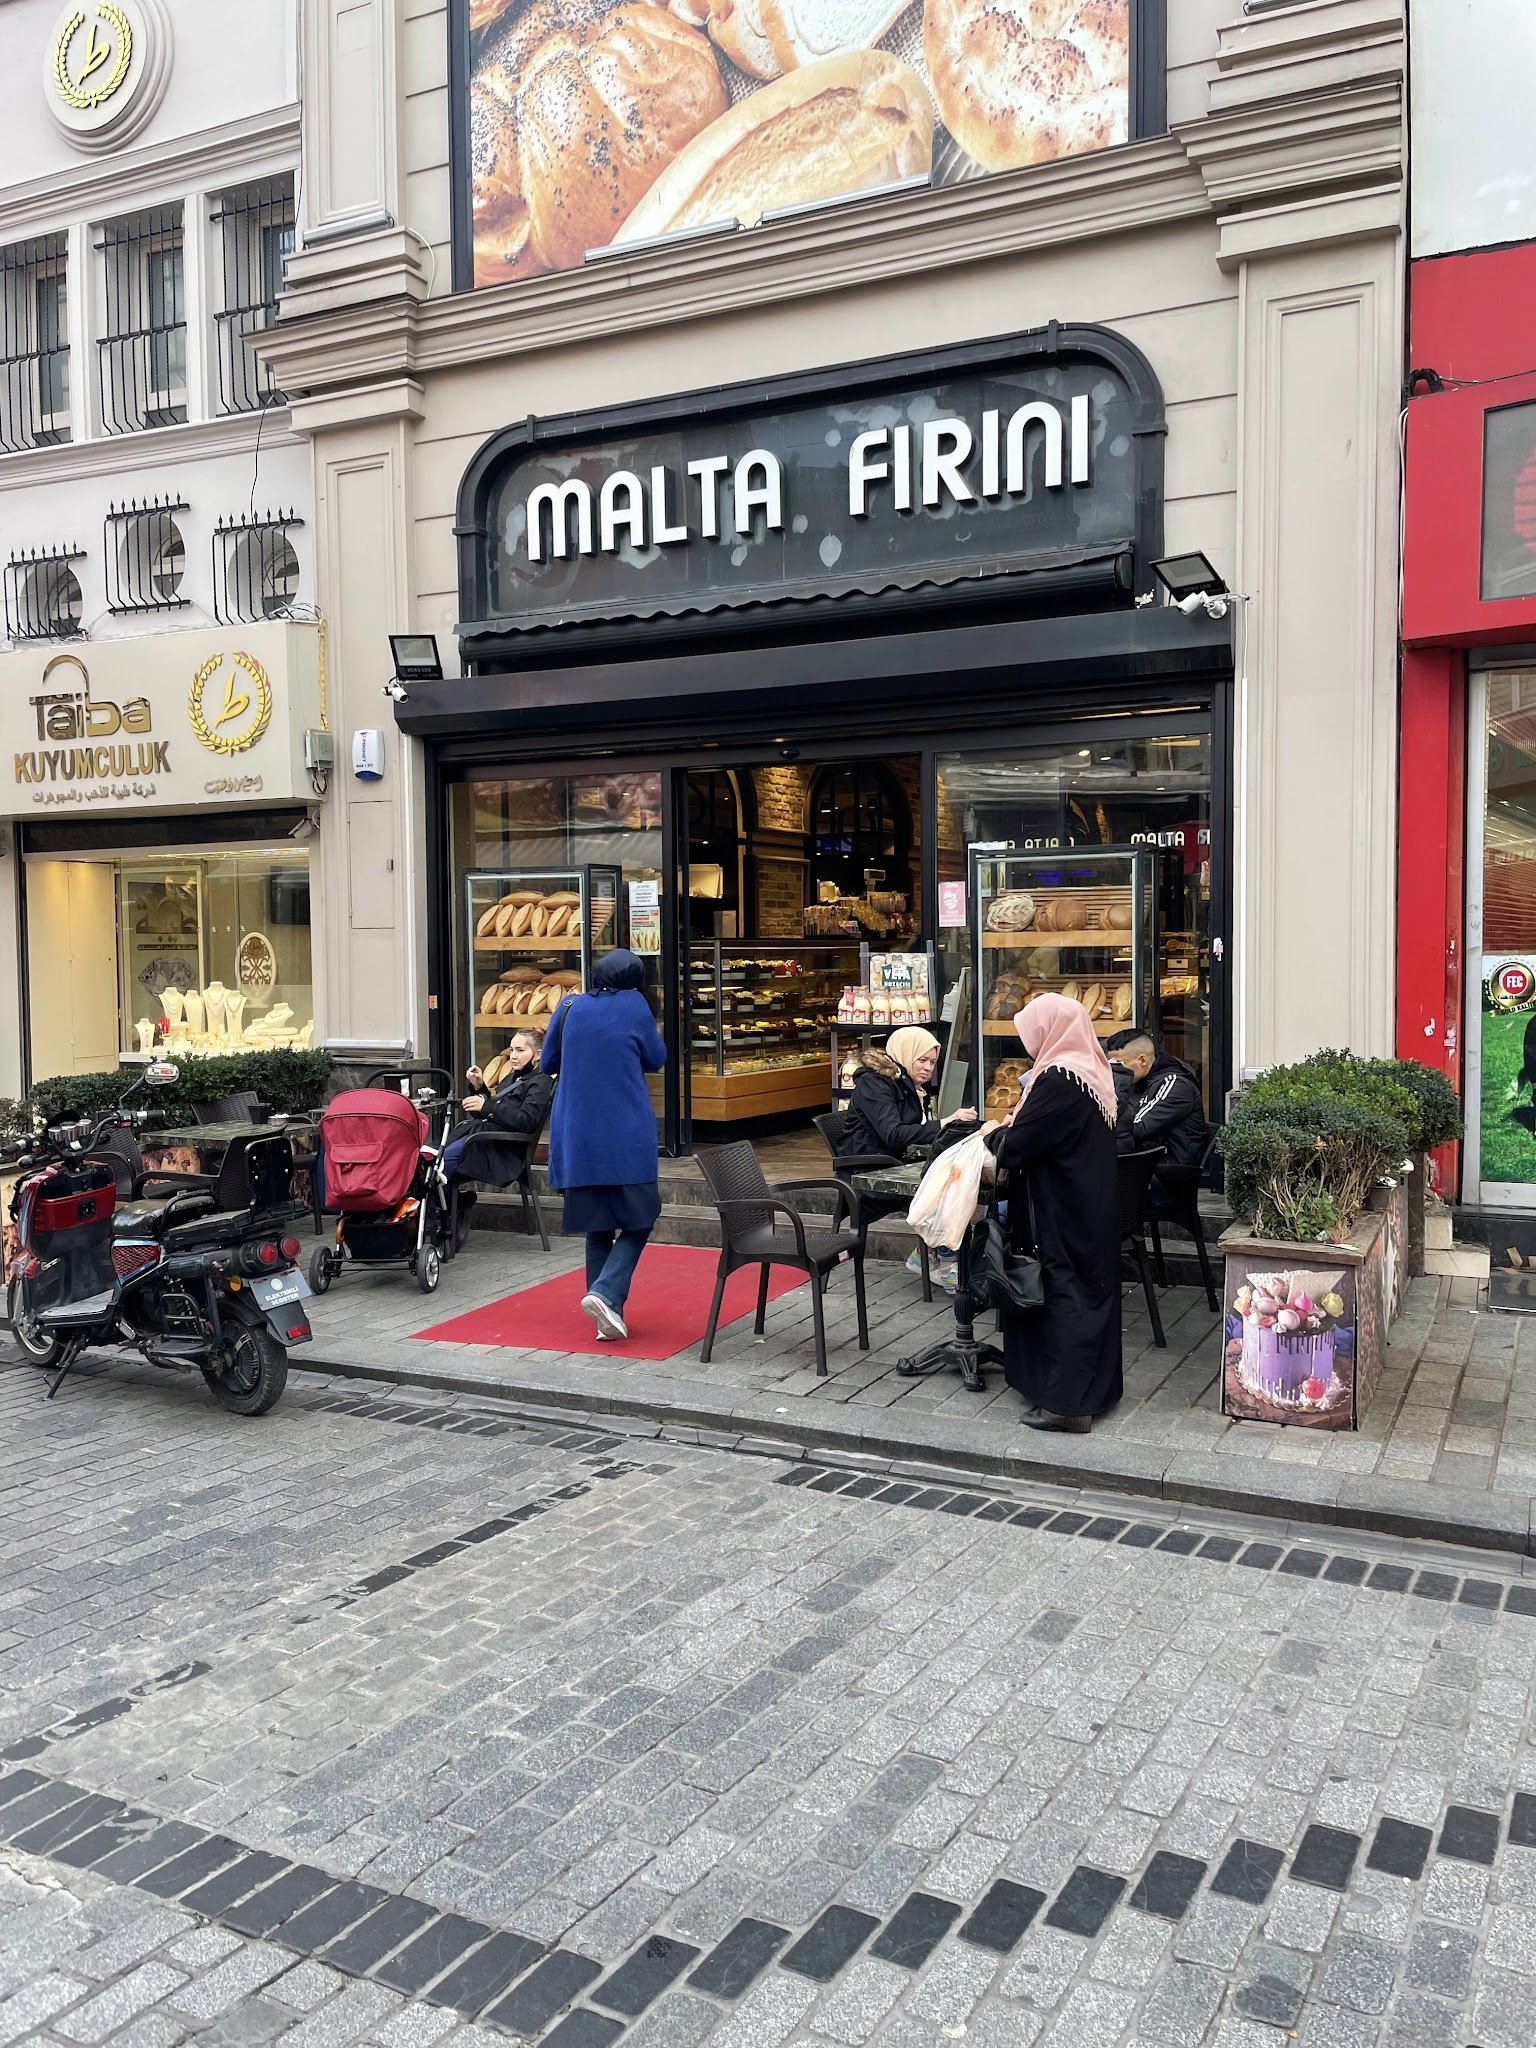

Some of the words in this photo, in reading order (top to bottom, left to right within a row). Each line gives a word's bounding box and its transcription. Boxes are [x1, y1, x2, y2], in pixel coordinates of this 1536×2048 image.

[525, 448, 784, 563] MALTA
[848, 393, 1092, 519] FIRINI
[14, 740, 172, 784] KUYUMCULUK
[132, 782, 157, 799] شركة
[1130, 830, 1185, 848] MALTA
[1506, 976, 1524, 988] FEC
[271, 1293, 300, 1306] SCOOTER
